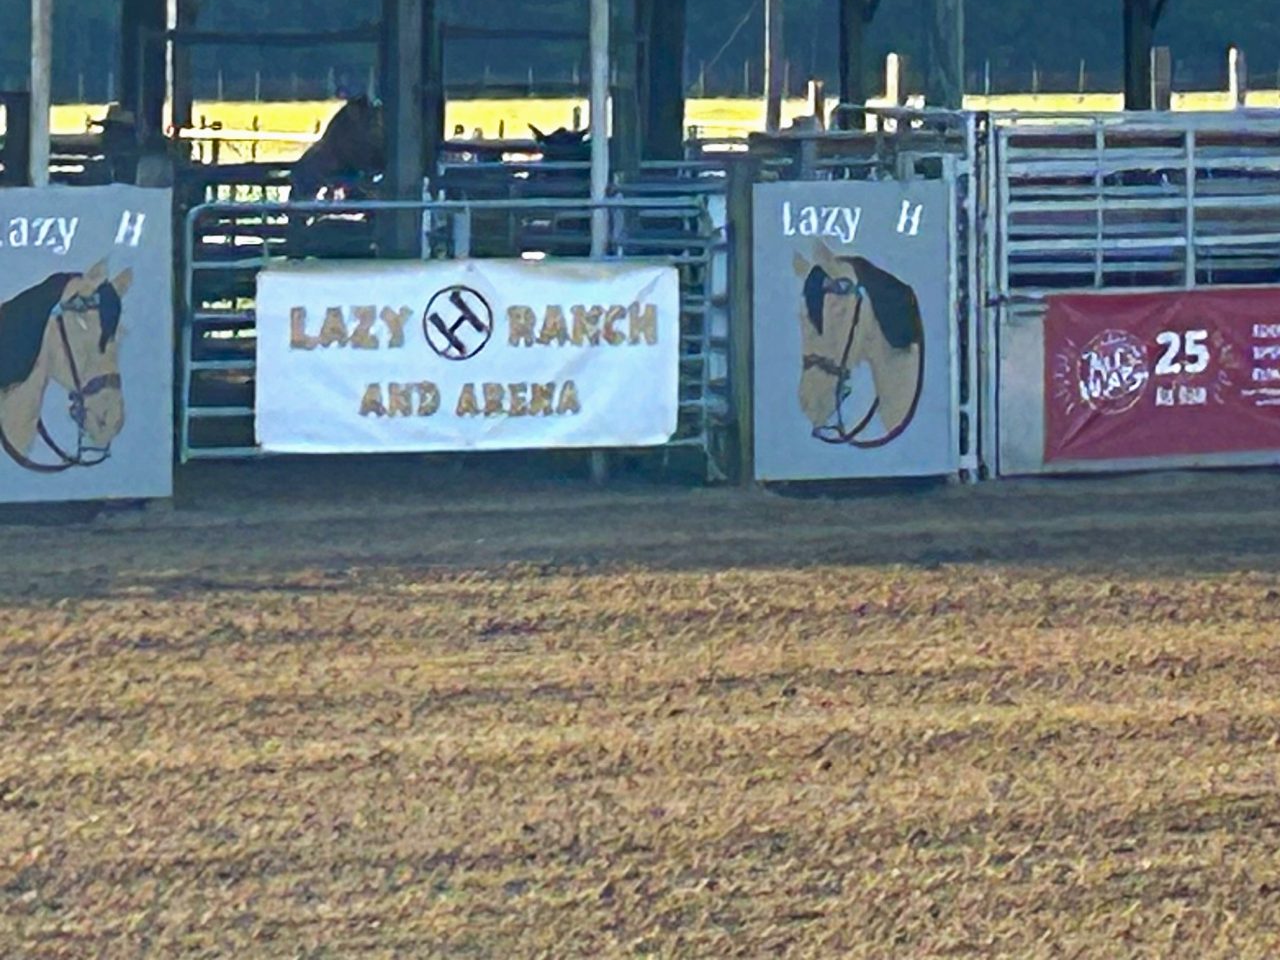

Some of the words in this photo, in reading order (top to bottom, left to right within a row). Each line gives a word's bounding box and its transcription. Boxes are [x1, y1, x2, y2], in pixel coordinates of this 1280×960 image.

[0, 217, 79, 255] azy
[114, 209, 146, 248] H
[896, 200, 923, 236] H
[289, 306, 413, 350] LAZY
[507, 302, 658, 348] RANCH
[1155, 329, 1210, 375] 25
[359, 382, 441, 418] AND
[456, 381, 581, 418] ARENA
